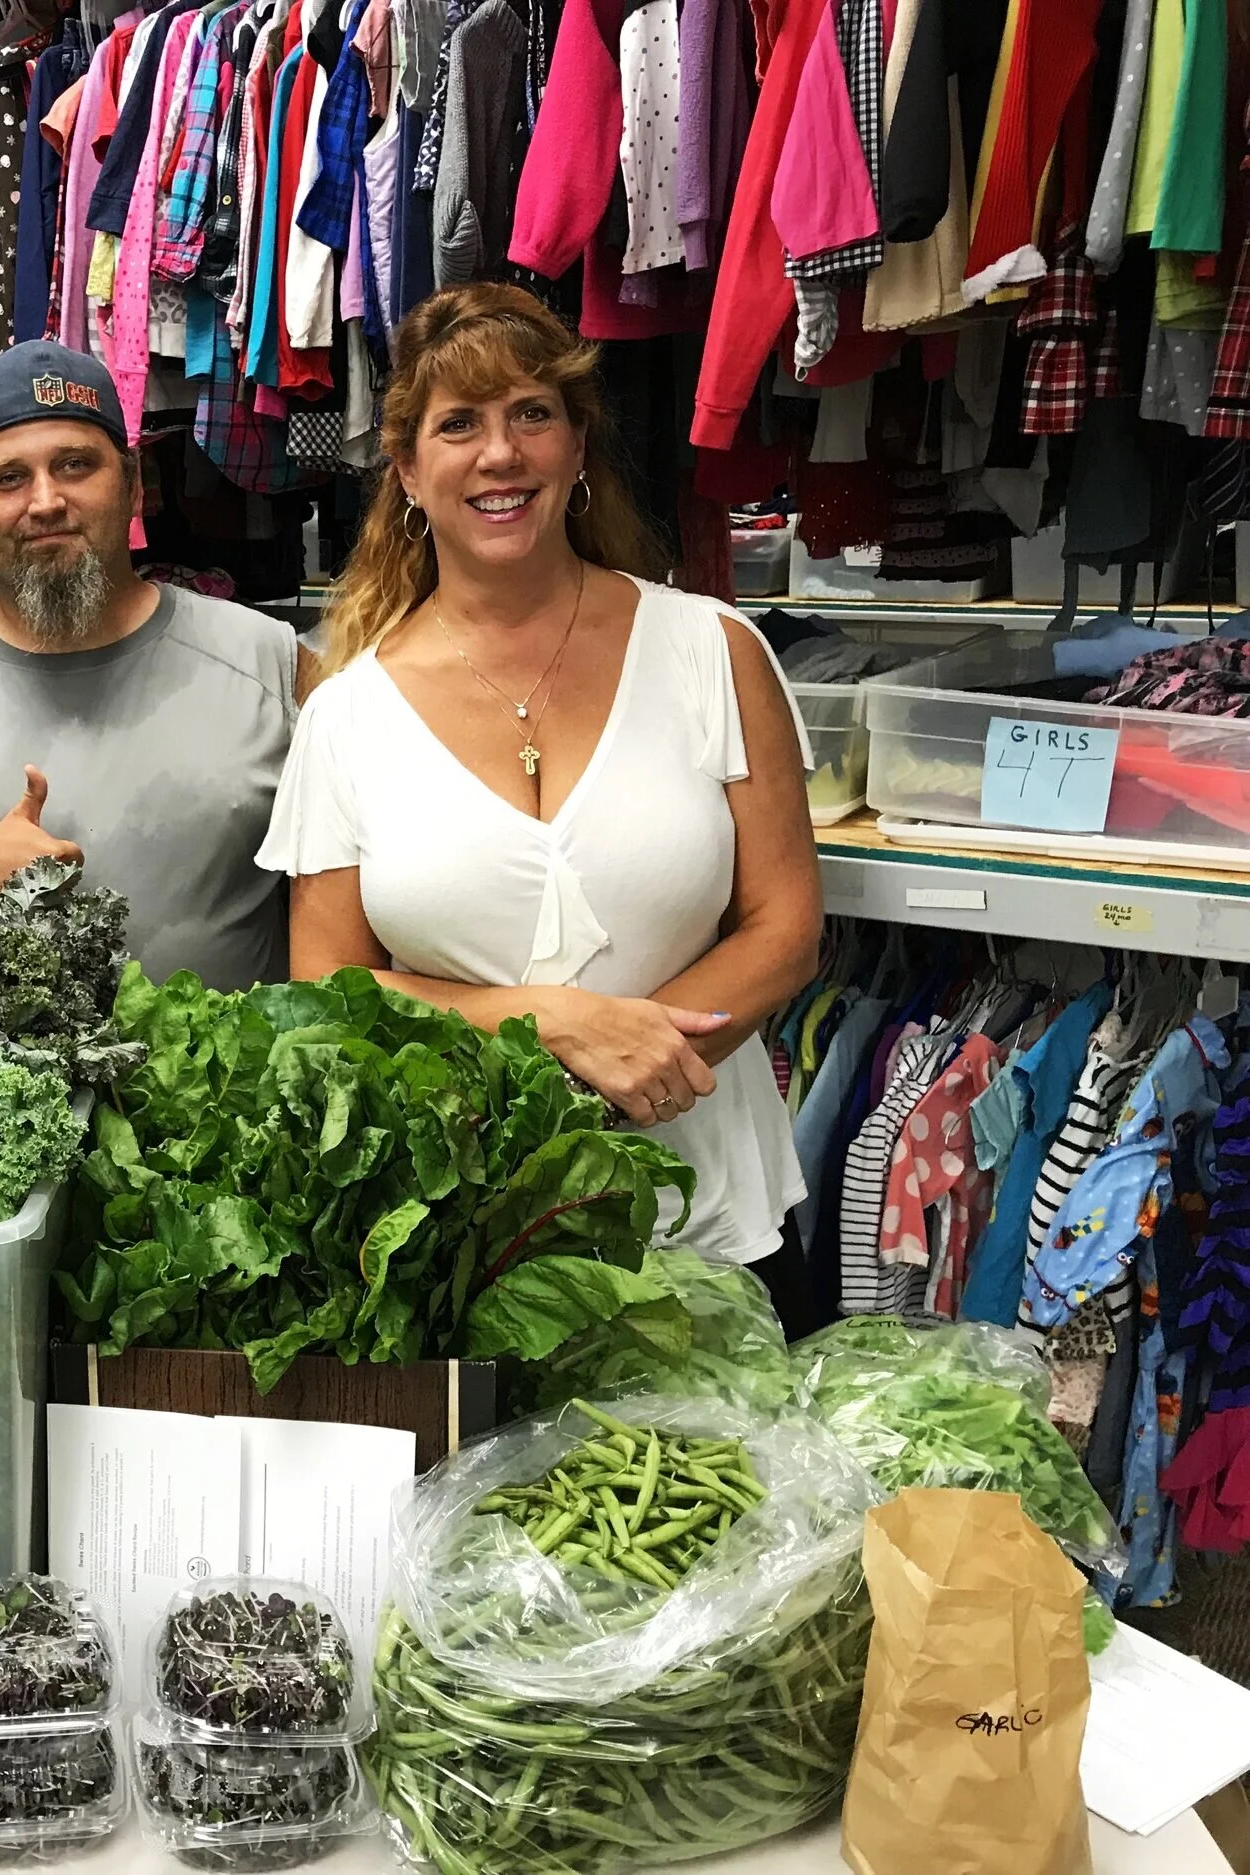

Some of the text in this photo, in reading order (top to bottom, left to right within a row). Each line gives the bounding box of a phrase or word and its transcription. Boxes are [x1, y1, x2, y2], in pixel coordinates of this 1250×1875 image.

[1010, 725, 1090, 751] GIRLS
[1102, 903, 1132, 914] GIRLS
[955, 1704, 1043, 1736] GARLC
